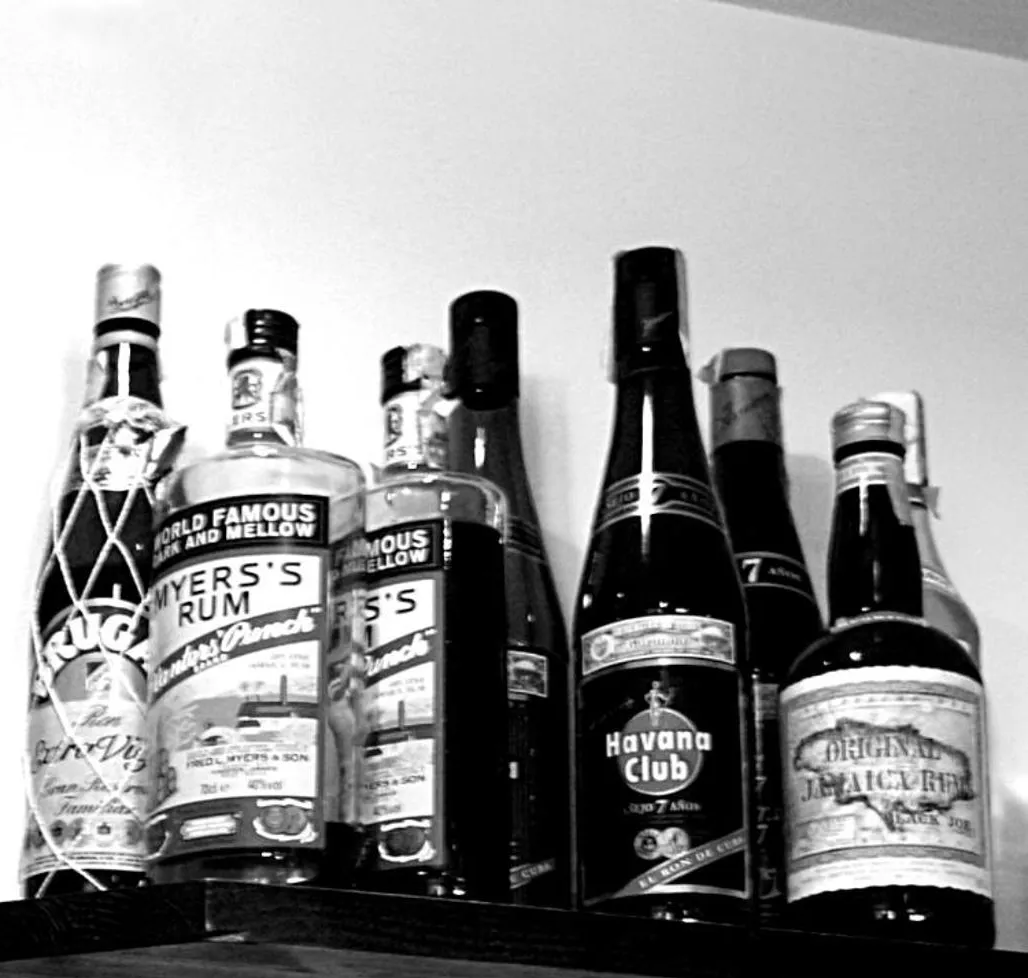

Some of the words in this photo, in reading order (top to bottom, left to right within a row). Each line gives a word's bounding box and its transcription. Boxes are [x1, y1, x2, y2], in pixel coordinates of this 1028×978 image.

[212, 502, 316, 528] FAMOUS
[185, 528, 221, 550] AND
[225, 521, 316, 541] MELLOW
[362, 547, 429, 574] ELLOW
[741, 558, 763, 584] 7
[155, 561, 302, 611] MYERS'S
[178, 590, 250, 627] RUM
[606, 731, 713, 758] Havana
[826, 735, 942, 762] ORIGINAL
[624, 752, 689, 783] Club
[654, 799, 669, 814] 7
[660, 858, 693, 877] RON
